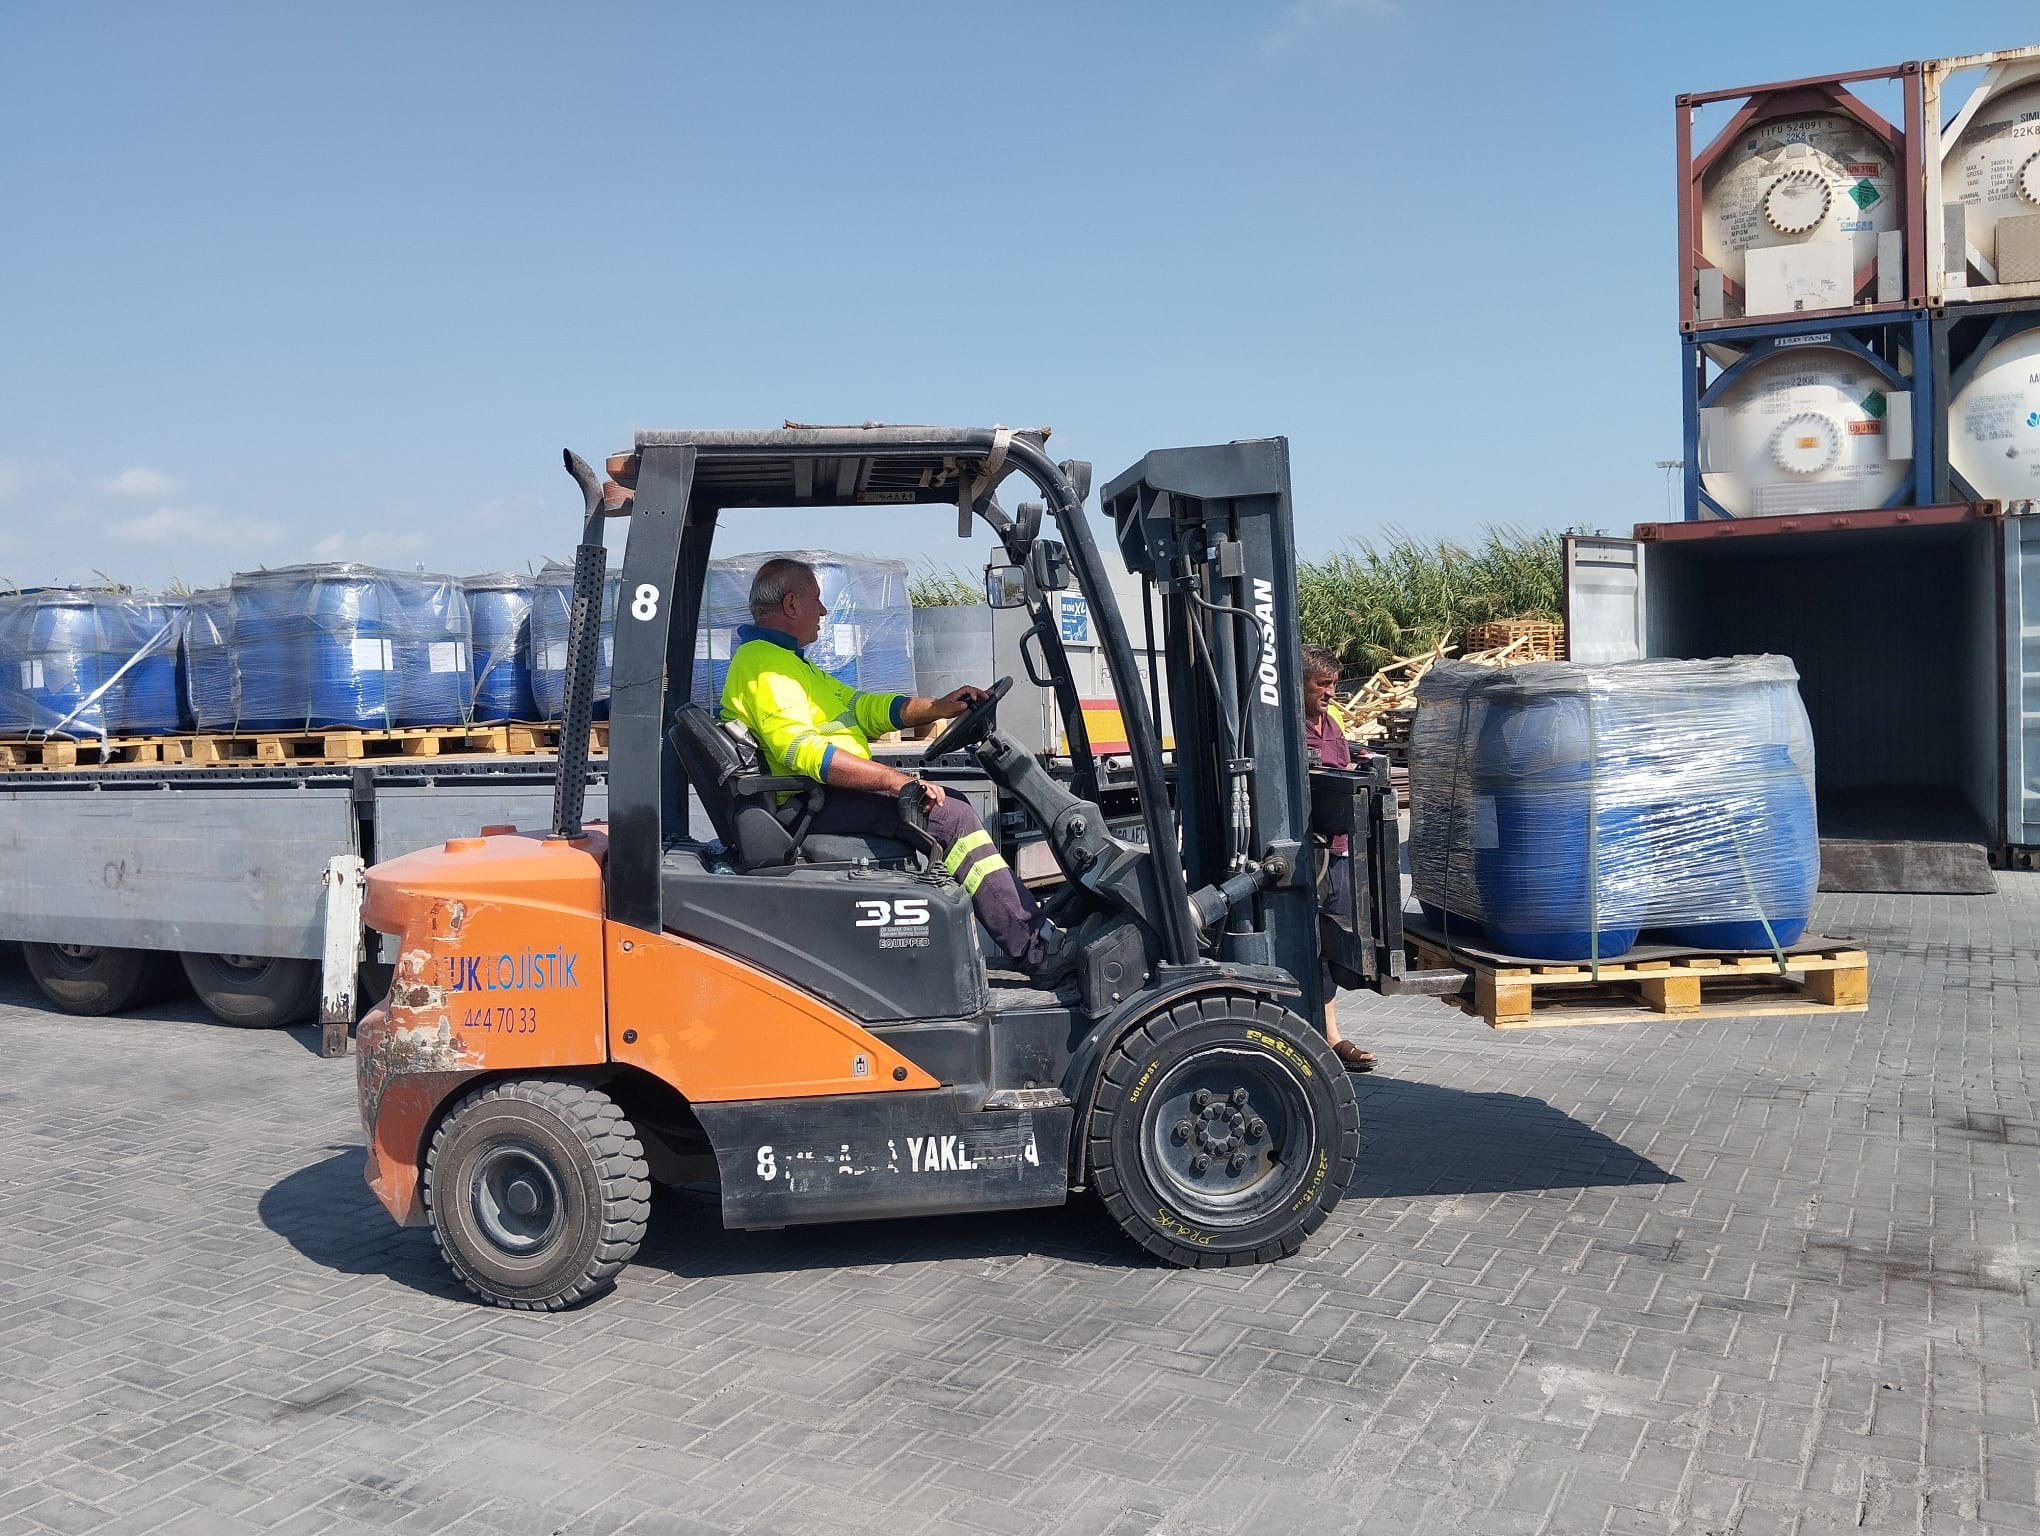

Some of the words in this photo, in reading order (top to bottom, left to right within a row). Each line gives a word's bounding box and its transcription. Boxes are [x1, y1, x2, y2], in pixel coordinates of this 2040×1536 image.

[1786, 131, 1807, 143] 22K8
[2013, 125, 2040, 138] 22K8
[631, 583, 660, 621] 8
[1253, 577, 1280, 707] DOOSAN
[855, 899, 930, 927] 35
[879, 937, 930, 949] EQUIPPED
[497, 1007, 514, 1034] 70
[518, 1007, 536, 1034] 33
